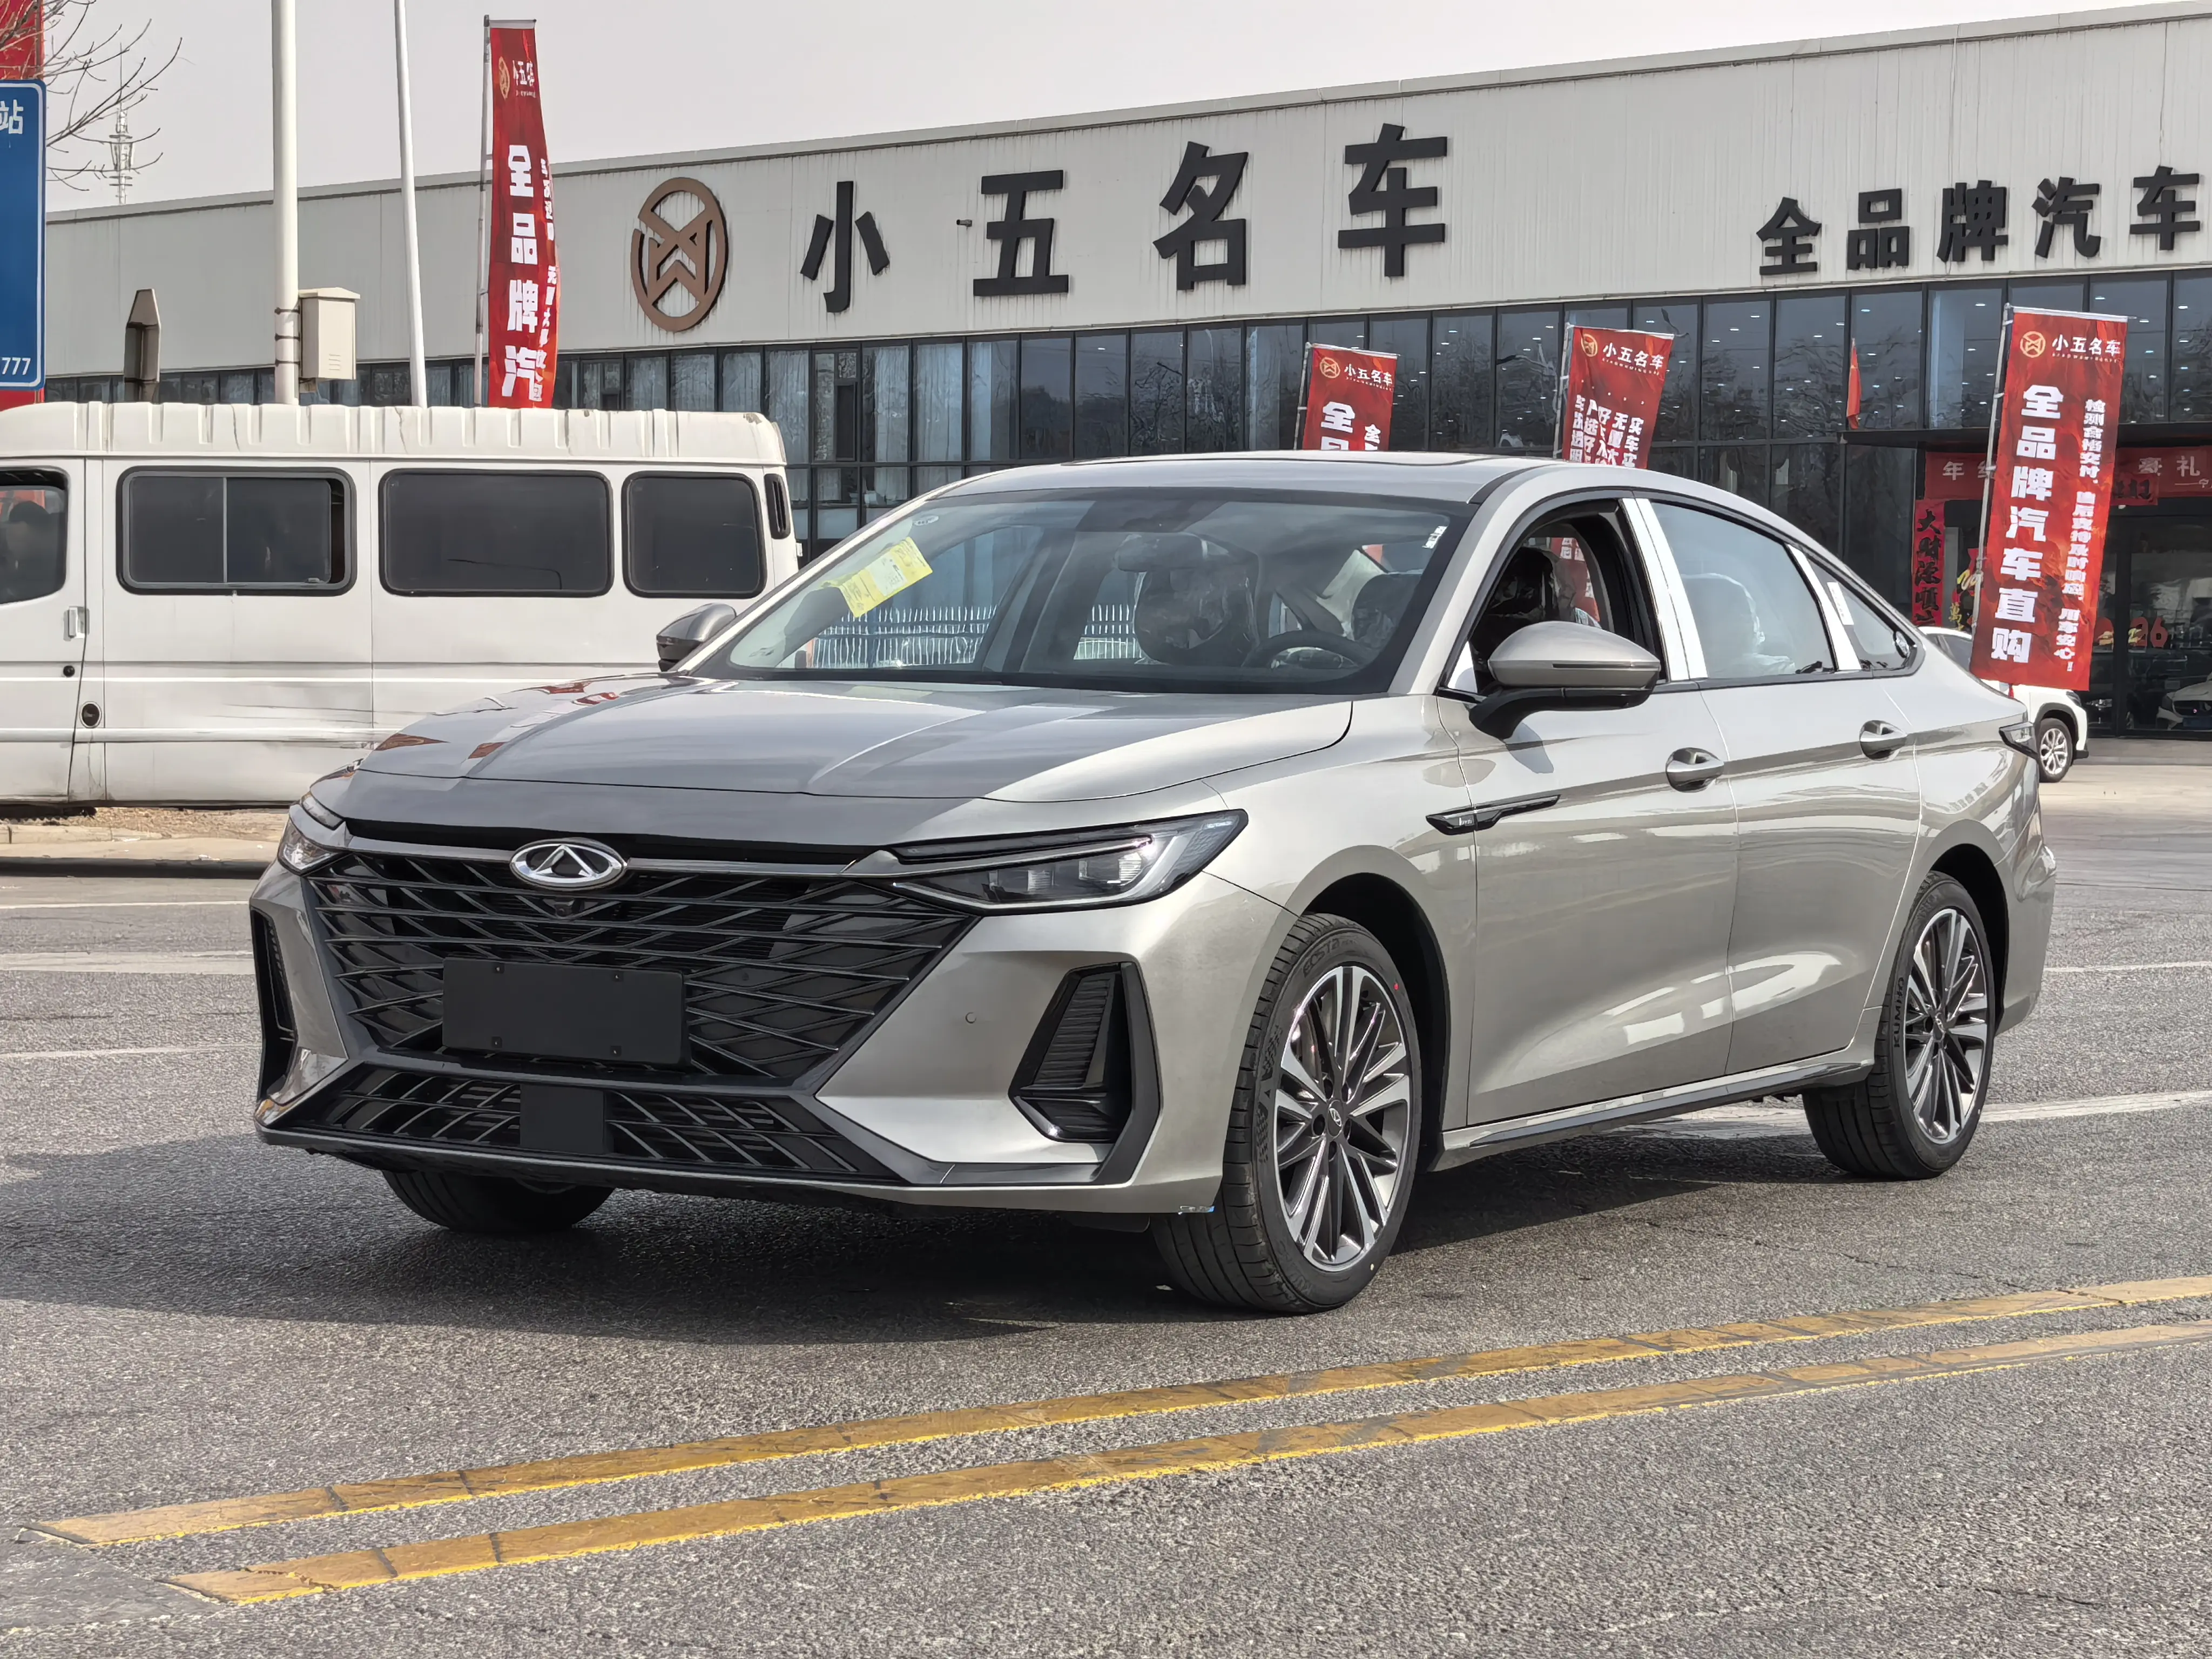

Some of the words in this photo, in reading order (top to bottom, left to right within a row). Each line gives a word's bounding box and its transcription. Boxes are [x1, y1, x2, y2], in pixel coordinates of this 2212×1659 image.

[0, 99, 24, 134] 站
[800, 123, 1448, 314] 小五名车
[1756, 166, 2201, 276] 全品牌汽车
[502, 144, 542, 401] 全品牌汽
[1602, 342, 1664, 370] 小五名车
[2052, 334, 2121, 357] 小五名车
[2, 357, 31, 375] 777
[1344, 363, 1393, 386] 小五名车
[1991, 385, 2064, 664] 全品牌汽车直购
